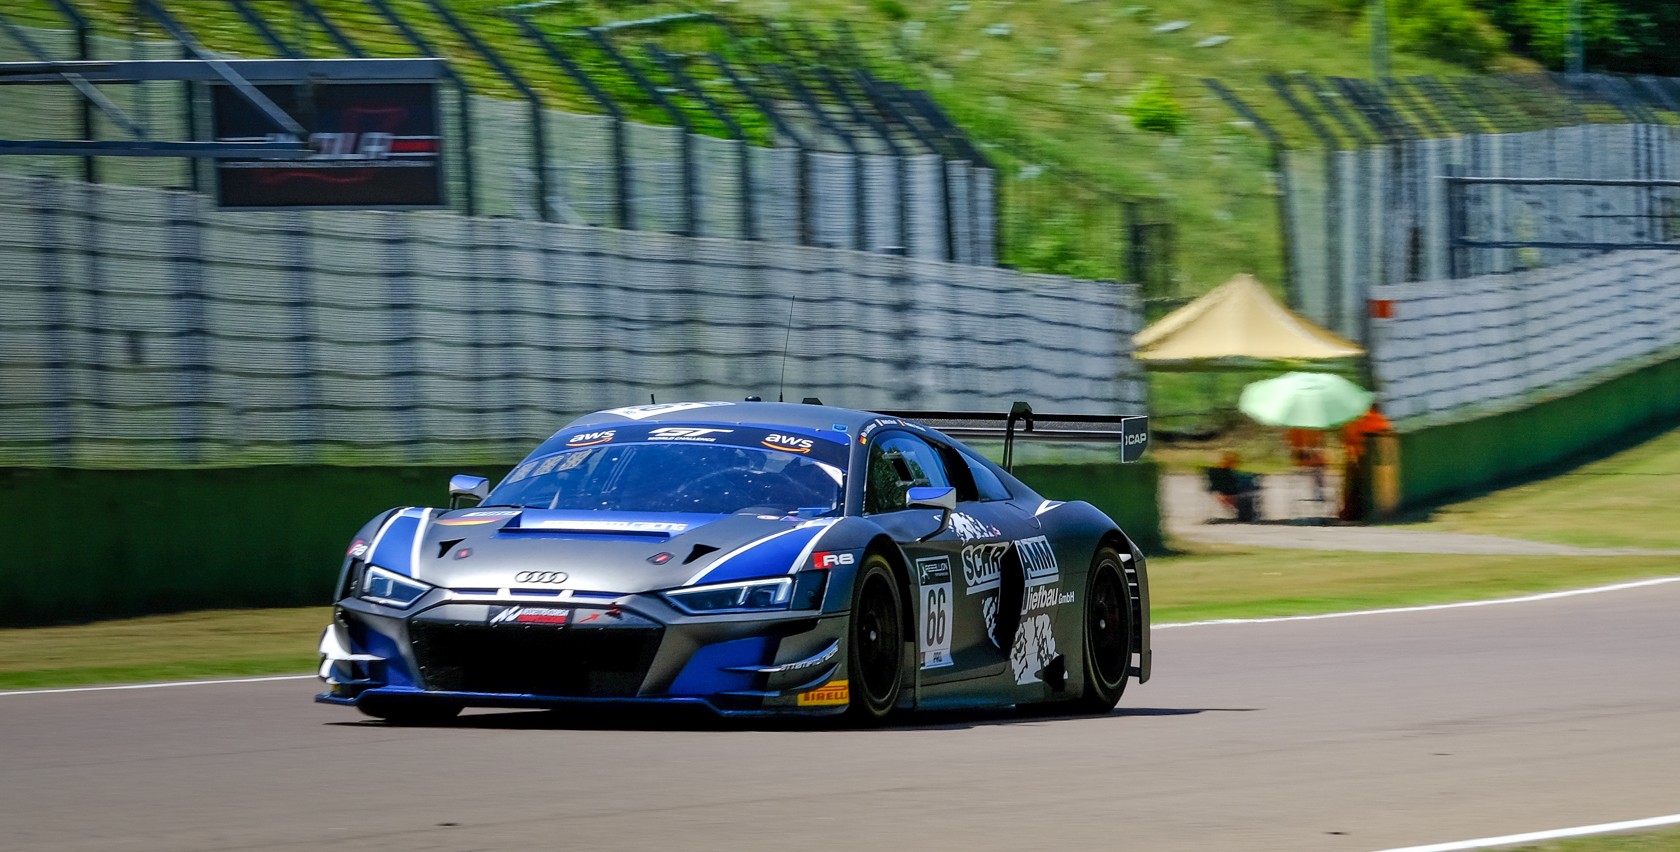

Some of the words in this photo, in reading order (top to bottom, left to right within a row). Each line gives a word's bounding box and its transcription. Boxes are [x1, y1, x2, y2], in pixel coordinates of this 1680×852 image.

[570, 429, 616, 443] aws
[648, 427, 735, 437] GT
[765, 433, 814, 448] aws
[822, 553, 855, 567] R8
[927, 587, 946, 647] 66
